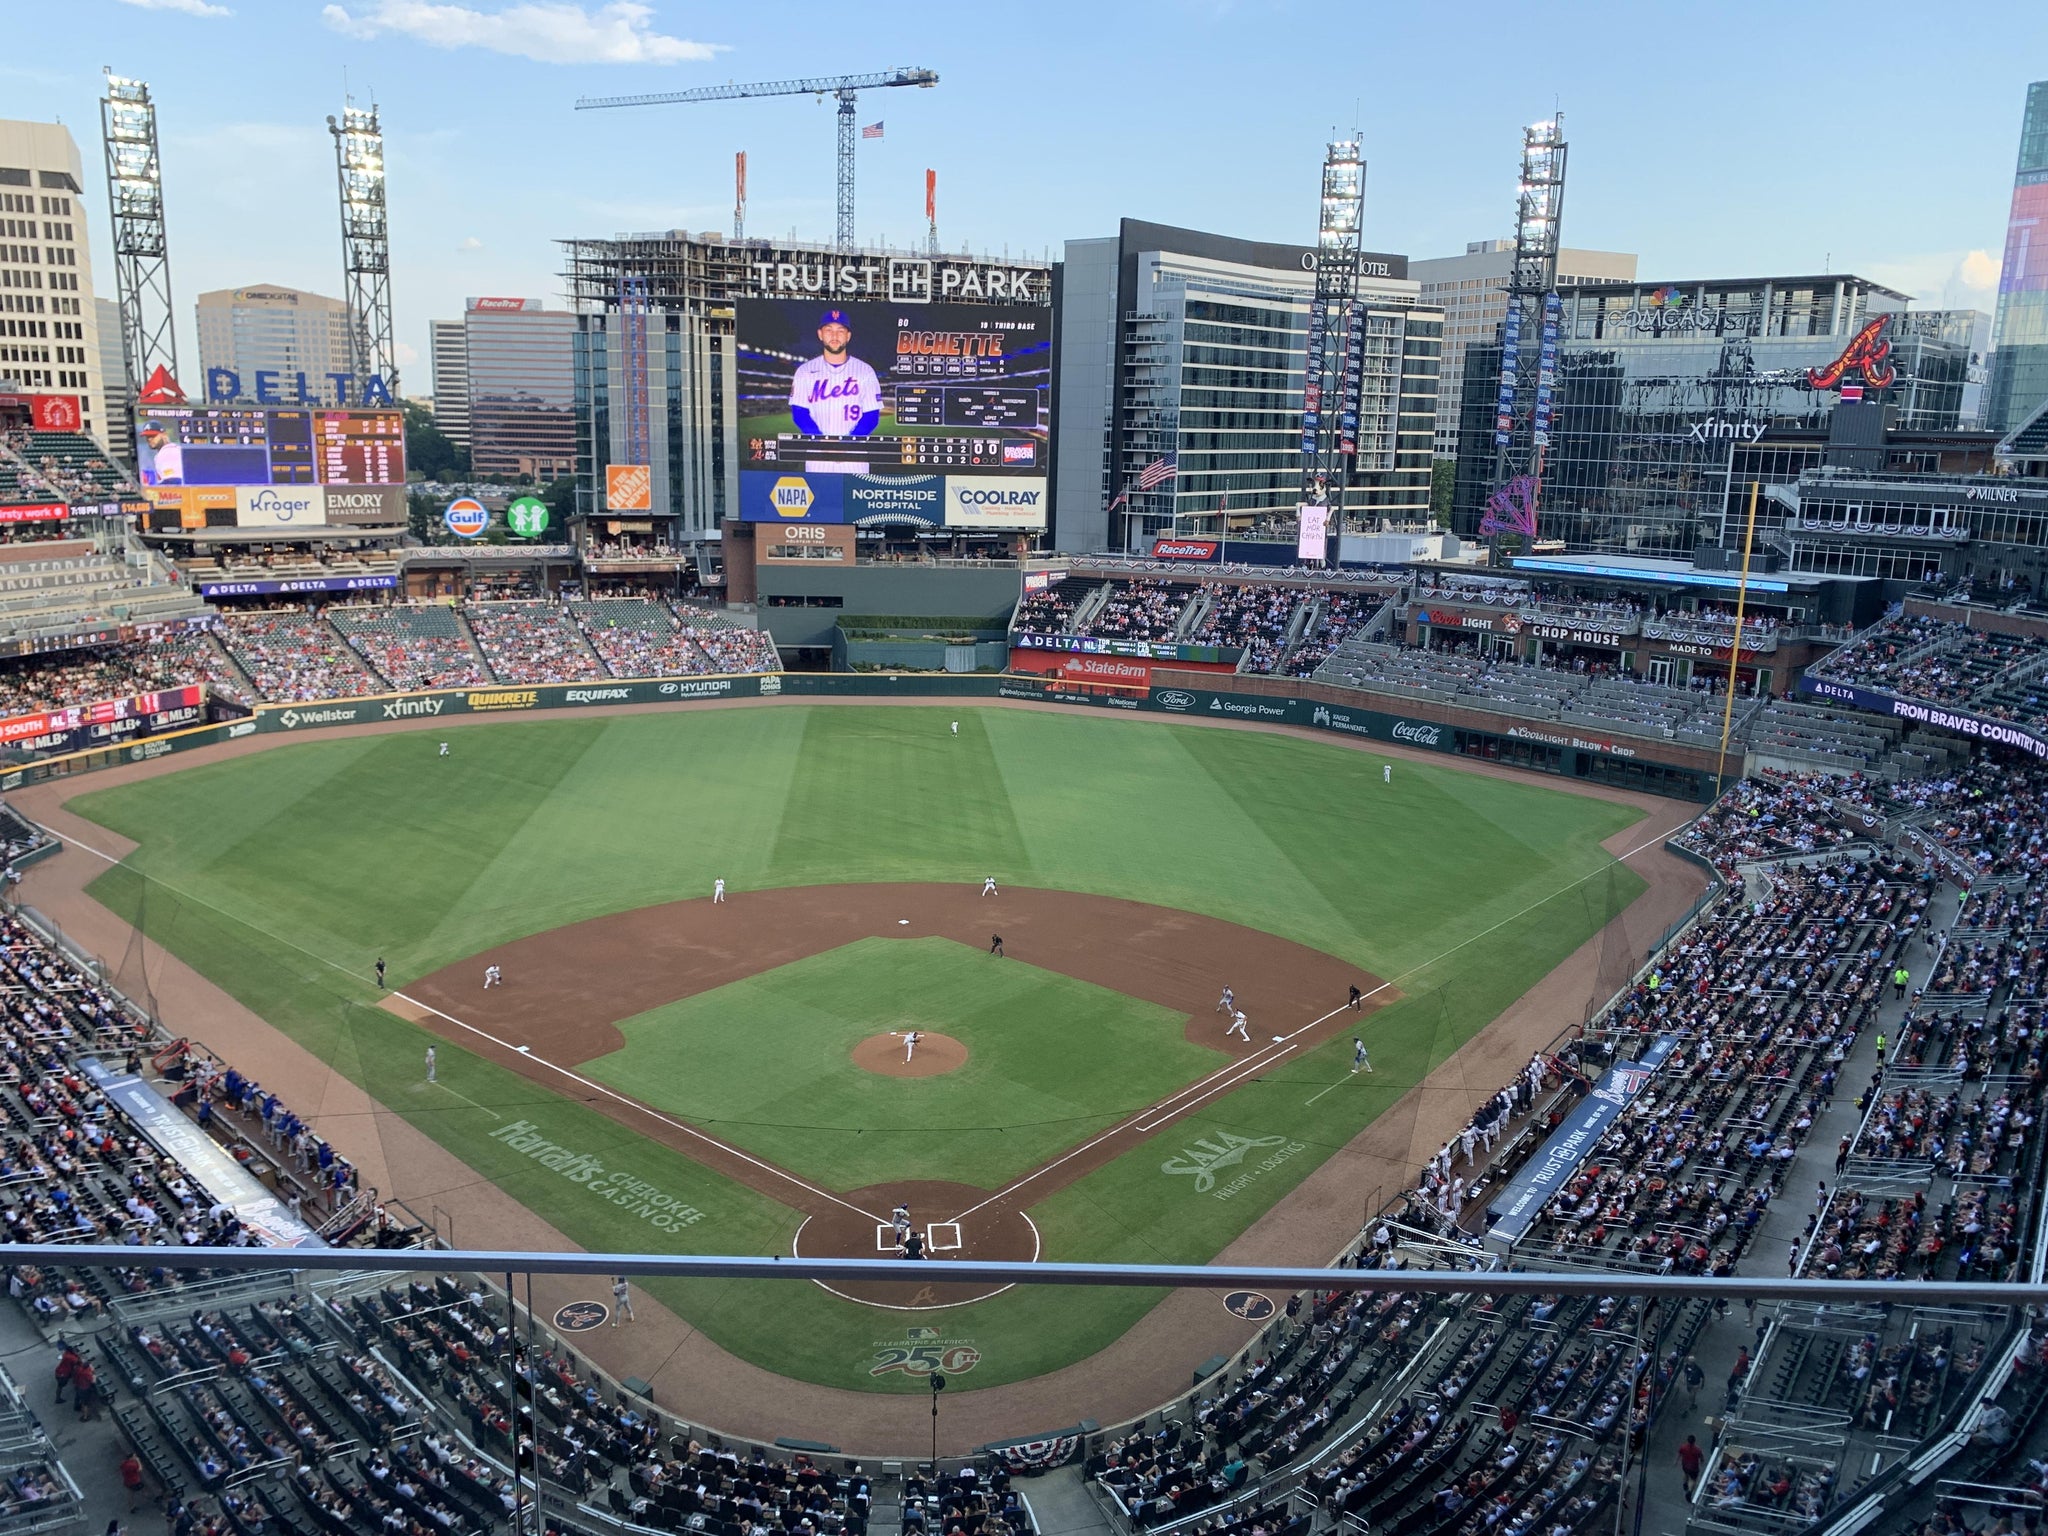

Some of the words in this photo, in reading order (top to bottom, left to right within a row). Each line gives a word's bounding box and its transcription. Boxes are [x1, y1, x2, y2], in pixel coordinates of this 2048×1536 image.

[754, 262, 881, 292] TRUIST
[941, 268, 1032, 298] PARK
[480, 300, 520, 308] RaceTrac
[898, 318, 909, 328] BO
[1608, 307, 1725, 327] COMCAST
[897, 331, 1004, 356] BICHETTE
[208, 368, 393, 404] DELTA
[808, 377, 859, 404] Mets
[844, 404, 860, 421] 19
[1689, 417, 1768, 444] xfinity
[946, 446, 952, 454] 0
[960, 446, 966, 454] 2
[974, 444, 983, 454] 0
[988, 444, 998, 455] 0
[960, 456, 966, 464] 2
[612, 470, 629, 488] THE
[608, 466, 650, 508] HOME
[328, 494, 384, 508] EMORY
[778, 488, 807, 506] NAPA
[852, 489, 937, 502] NORTHSIDE
[959, 490, 1040, 506] COOLRAY
[1976, 488, 2018, 502] MILNER
[25, 508, 52, 518] work
[87, 506, 98, 514] PM
[250, 490, 310, 521] Kroger
[868, 501, 922, 510] HOSPITAL
[448, 512, 484, 523] Gulf
[785, 526, 826, 540] ORIS
[1158, 544, 1208, 556] RaceTrac
[221, 584, 258, 593] DELTA
[291, 581, 326, 590] DELTA
[358, 578, 392, 587] DELTA
[1429, 610, 1462, 626] Coors
[1462, 616, 1492, 630] LIGHT
[1035, 636, 1080, 649] DELTA
[1084, 641, 1096, 650] NL
[1532, 626, 1568, 640] CHOP
[1574, 630, 1620, 646] HOUSE
[1669, 644, 1696, 654] MADE
[1699, 646, 1712, 656] TO
[680, 680, 730, 692] HYUNDAI
[760, 676, 780, 684] PAPA
[468, 691, 538, 706] QUIKRETE
[566, 688, 630, 702] EQUIFAX
[1167, 693, 1188, 706] Ford
[1824, 686, 1854, 700] DELTA
[168, 707, 198, 720] MLB+
[383, 697, 444, 719] xfinity
[1224, 702, 1256, 714] Georgia
[1259, 705, 1285, 716] Power
[50, 716, 66, 728] AL
[301, 710, 356, 723] Wellstar
[1332, 714, 1350, 722] KAISER
[4, 720, 43, 736] SOUTH
[110, 718, 141, 733] MLB+
[1332, 721, 1367, 733] PERMANENTE
[1392, 721, 1442, 745] Coca-Cola
[1894, 701, 1929, 722] FROM
[1930, 710, 1979, 734] BRAVES
[1981, 723, 2035, 752] COUNTRY
[2035, 740, 2046, 757] TO
[35, 733, 69, 748] MLB+
[1518, 726, 1544, 741] Coors
[1544, 734, 1568, 746] LIGHT
[1572, 738, 1602, 751] BELOW
[1612, 746, 1636, 757] CHOP
[151, 1113, 188, 1142] TRUIST
[183, 1144, 216, 1168] PARK
[1563, 1130, 1590, 1151] PARK
[1161, 1130, 1288, 1194] SAIA
[1212, 1172, 1256, 1201] FREIGHT
[1257, 1142, 1306, 1172] LOGISTICS
[1532, 1156, 1564, 1186] TRUIST
[608, 1172, 708, 1225] CHEROKEE
[1508, 1194, 1529, 1217] WELCOME
[586, 1180, 688, 1234] CASINOS
[868, 1346, 979, 1378] 250
